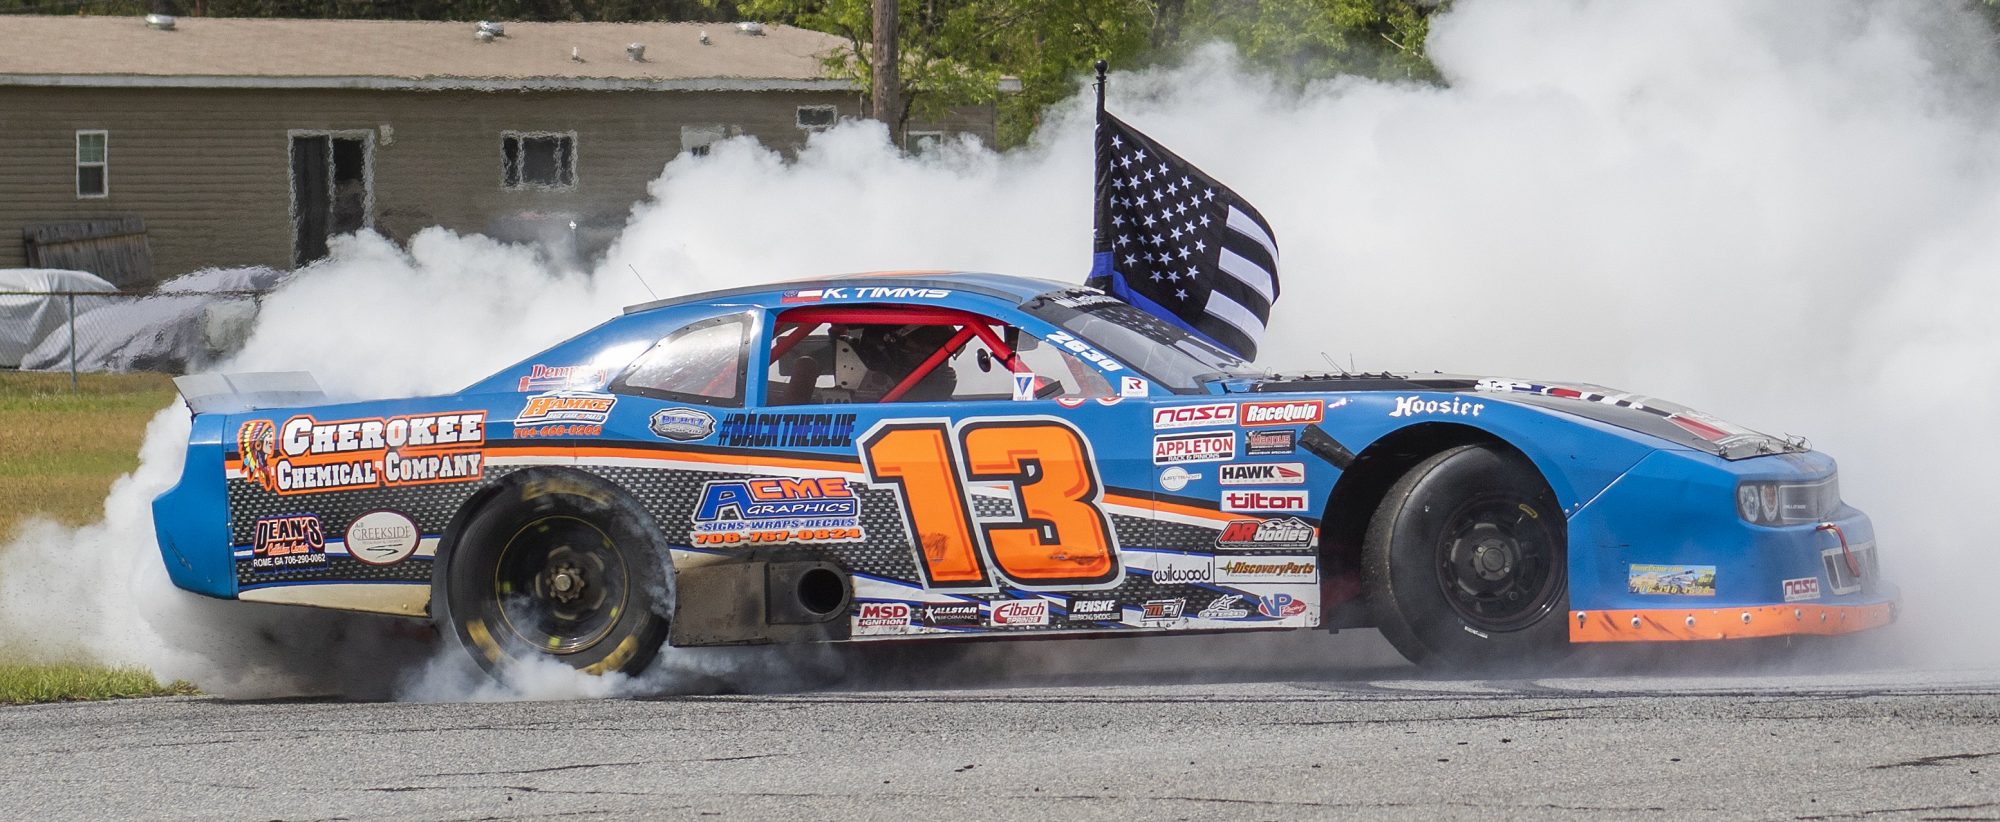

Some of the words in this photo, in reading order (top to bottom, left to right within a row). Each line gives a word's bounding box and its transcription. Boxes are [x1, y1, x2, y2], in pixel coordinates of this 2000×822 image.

[823, 288, 848, 299] K.
[854, 287, 952, 299] TIMMS
[1046, 330, 1124, 372] 2630
[520, 397, 612, 417] HAMKE
[1155, 405, 1235, 423] nasa
[1246, 403, 1318, 423] RaceQuip
[1389, 395, 1485, 417] Hoosier
[282, 413, 484, 456] CHEROKEE
[718, 413, 856, 447] #BACKTHEBLUE
[1156, 438, 1233, 456] APPLETON
[276, 459, 376, 490] CHEMICAL
[385, 451, 482, 482] COMPANY
[1222, 466, 1275, 480] HAWK
[694, 477, 852, 521] ACME
[860, 418, 1123, 590] 13
[1226, 493, 1303, 509] tilton
[747, 502, 851, 515] GRAPHICS
[254, 516, 324, 553] DEAN'S
[353, 525, 411, 541] CREEKSIDE
[693, 528, 862, 545] 706-767-0824
[1254, 526, 1310, 542] bodies
[253, 557, 274, 567] ROME,
[274, 556, 284, 565] GA
[1232, 561, 1315, 576] DiscoveryParts
[1153, 561, 1211, 582] wilwood
[1784, 579, 1818, 596] nasa
[862, 605, 908, 619] MSD
[934, 606, 977, 614] ALLSTAR
[993, 603, 1044, 624] Eibach
[1073, 600, 1115, 612] PENSKE
[1261, 593, 1292, 617] VP
[862, 618, 905, 626] IGNITION
